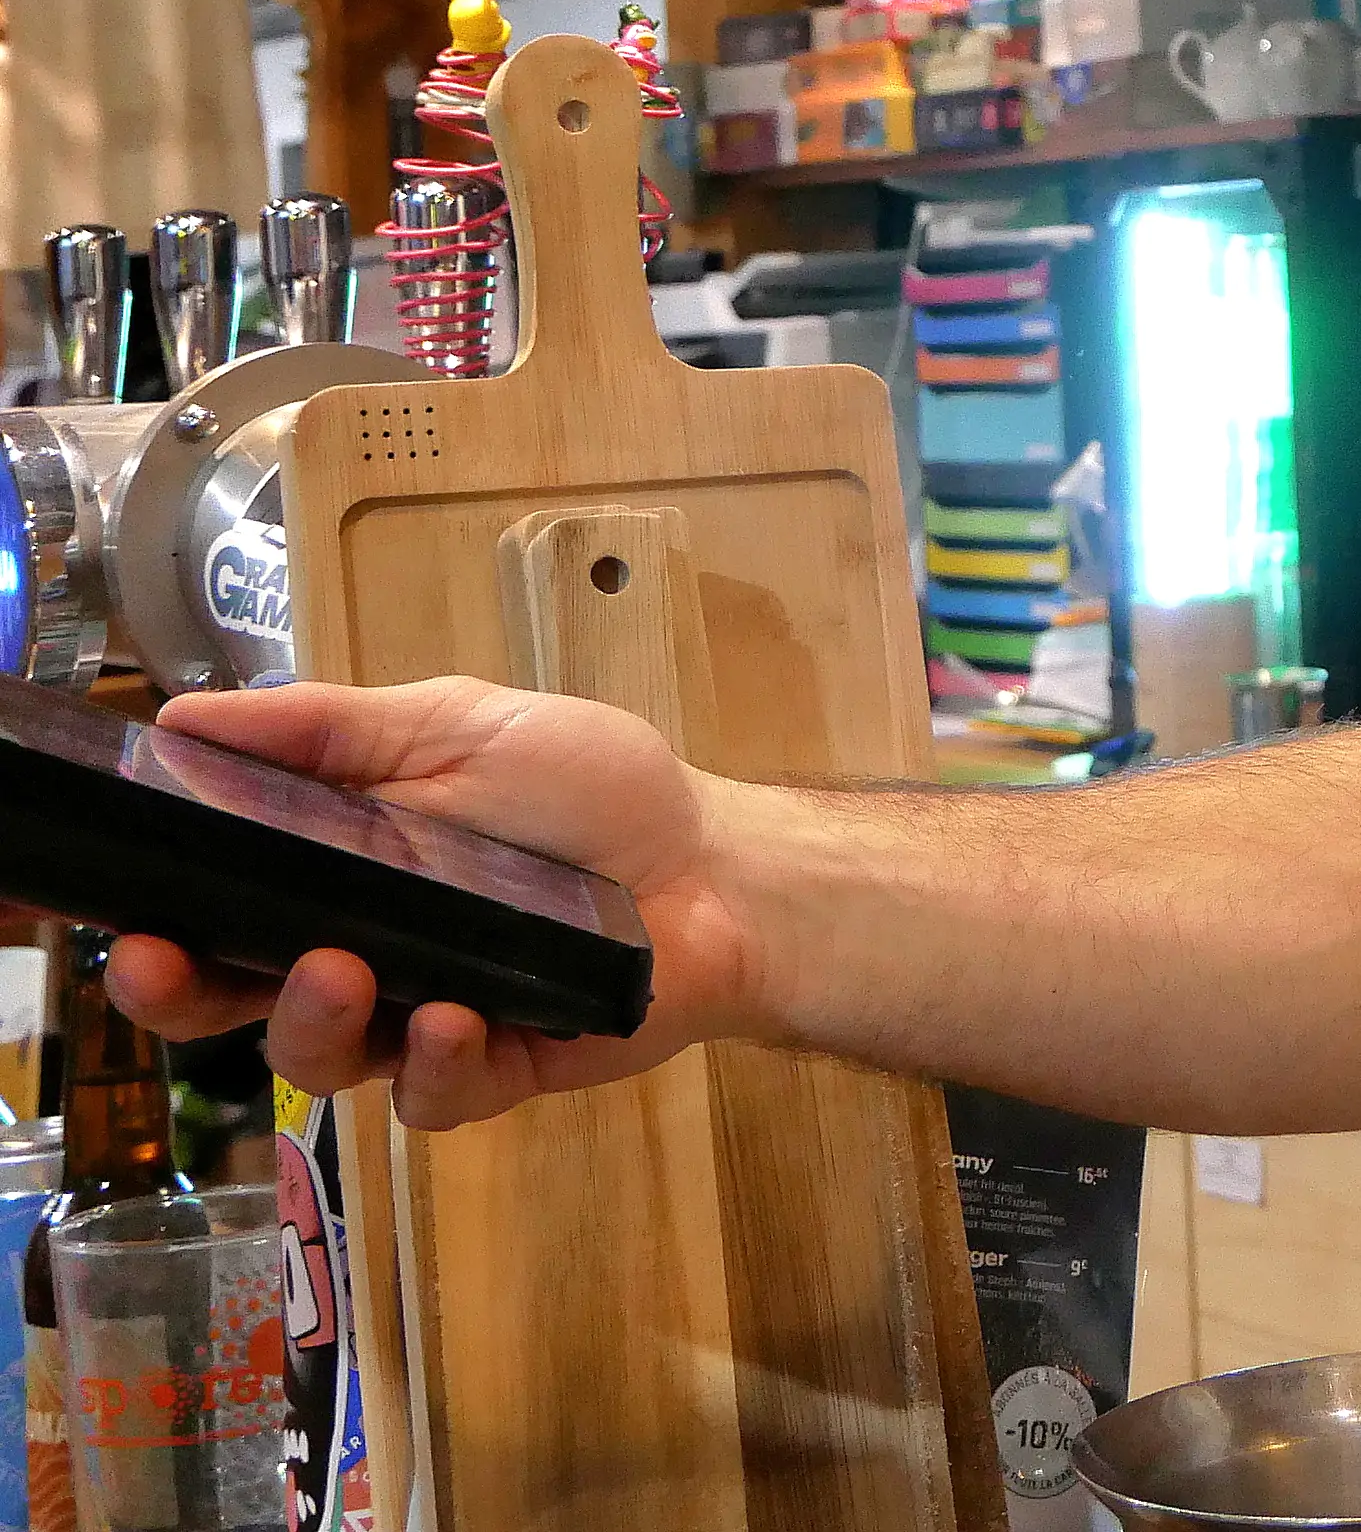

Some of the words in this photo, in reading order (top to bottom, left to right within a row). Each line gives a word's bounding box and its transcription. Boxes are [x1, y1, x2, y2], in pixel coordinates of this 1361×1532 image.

[952, 1154, 995, 1174] any
[969, 1250, 1009, 1267] ger
[1005, 1419, 1074, 1451] -10%
